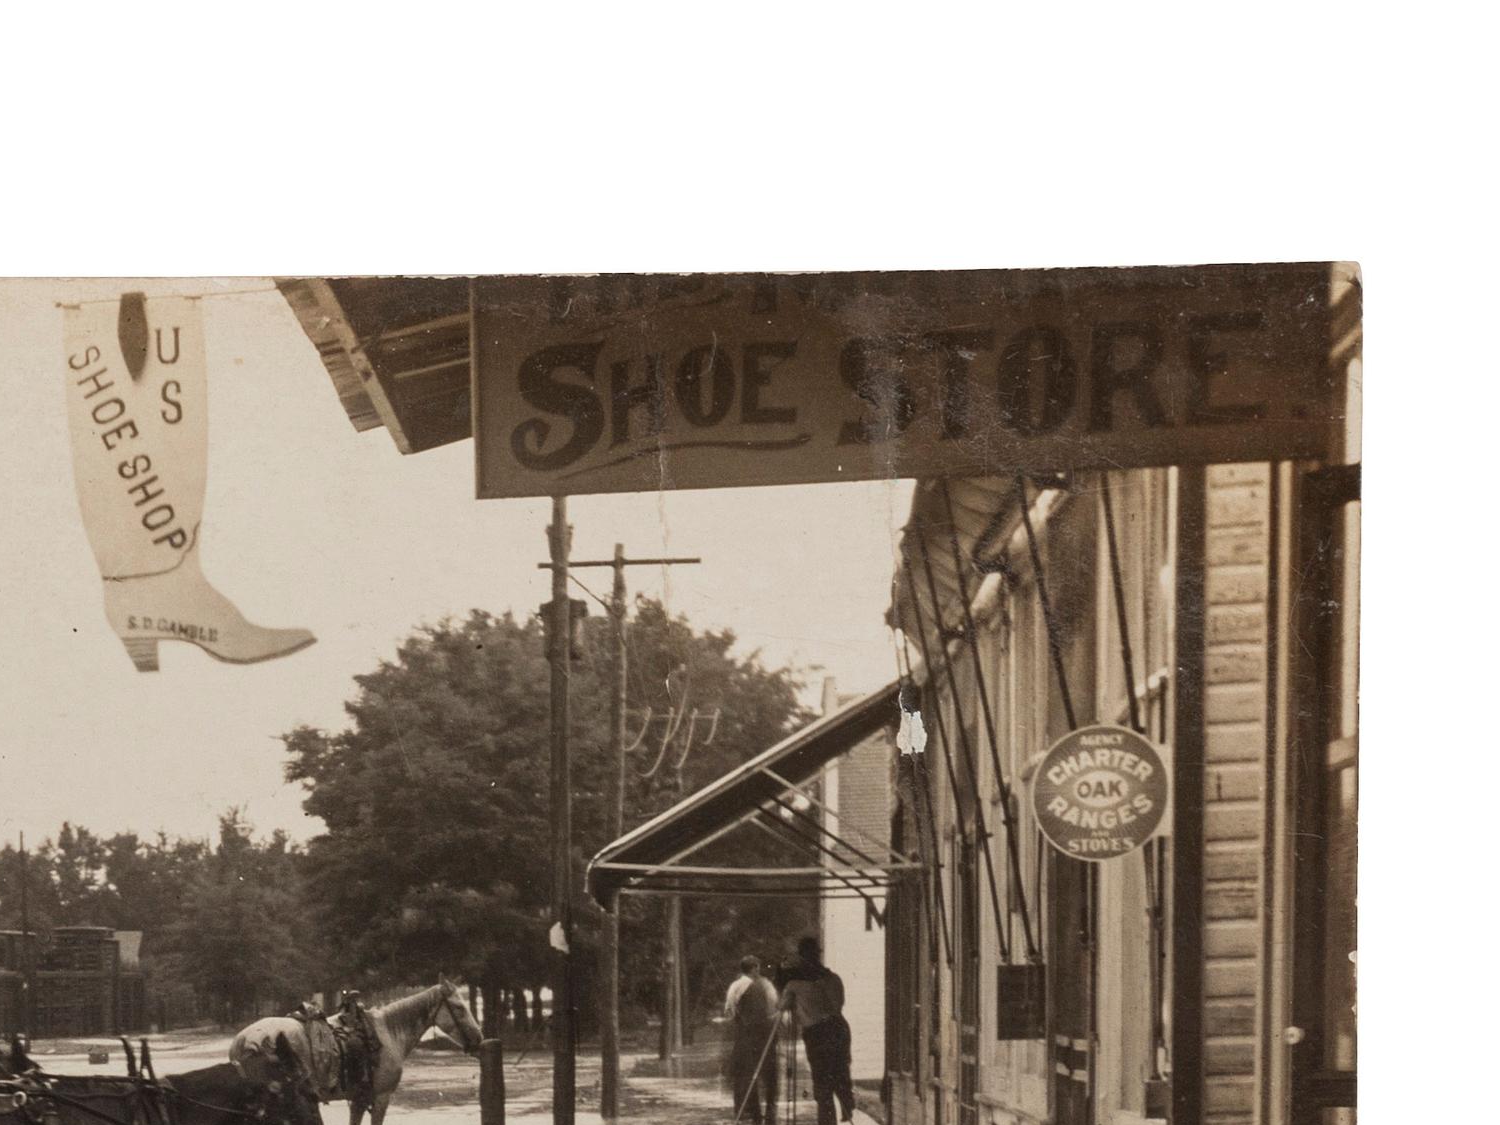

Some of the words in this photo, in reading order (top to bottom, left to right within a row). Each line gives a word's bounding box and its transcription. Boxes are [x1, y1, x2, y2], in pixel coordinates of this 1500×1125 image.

[155, 327, 181, 364] U
[161, 380, 183, 424] S
[509, 337, 799, 471] SHOE
[68, 345, 140, 451] SHOE
[117, 454, 188, 550] SHOP
[1079, 733, 1124, 746] AGENCY
[1046, 748, 1154, 786] CHARTER
[1077, 779, 1123, 799] OAK
[1047, 793, 1154, 830] RANGES
[1067, 837, 1135, 852] STOVES
